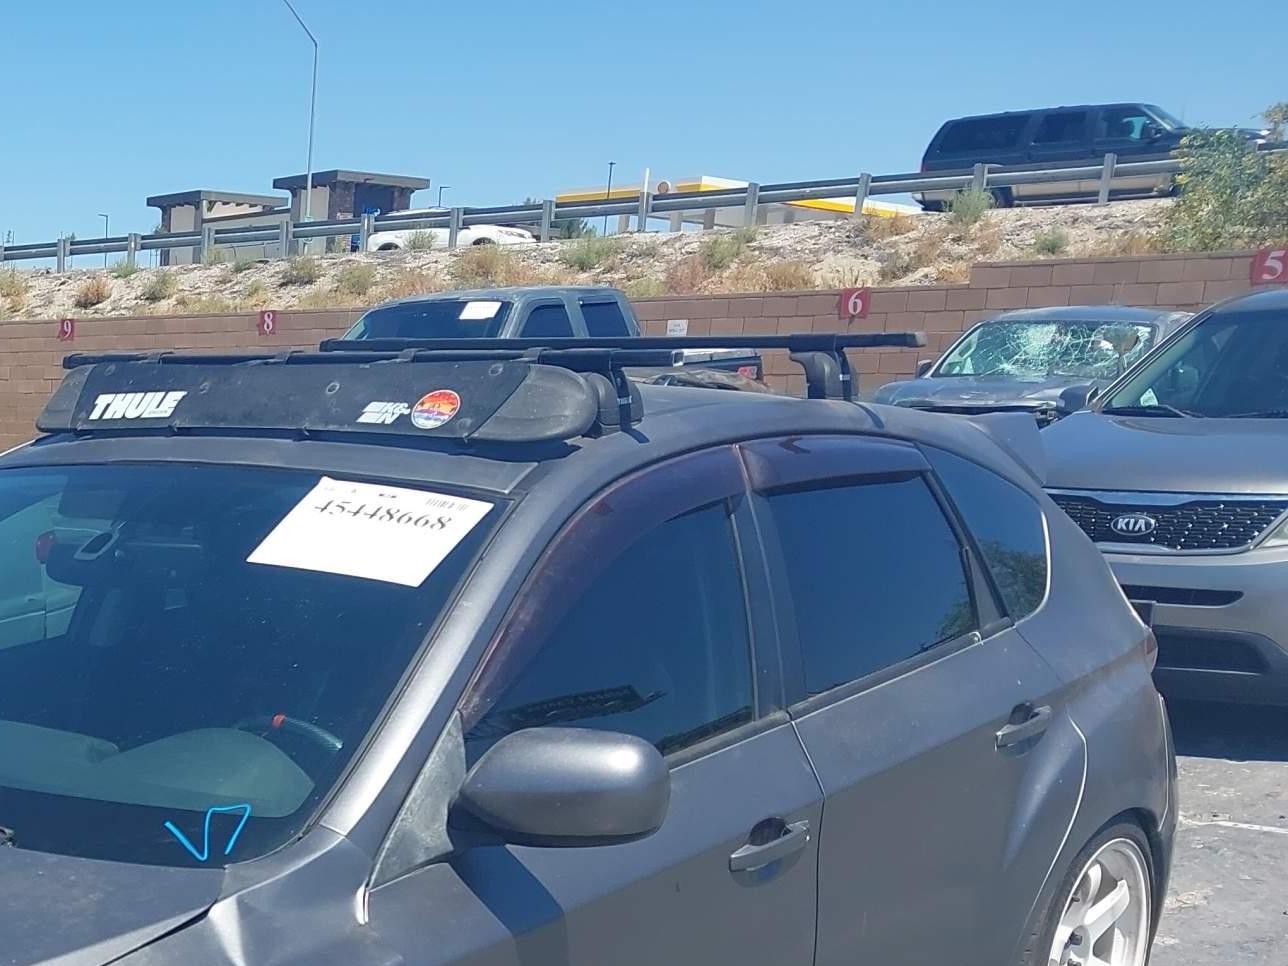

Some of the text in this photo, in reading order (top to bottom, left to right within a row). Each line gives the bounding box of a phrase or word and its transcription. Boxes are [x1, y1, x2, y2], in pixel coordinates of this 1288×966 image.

[1262, 250, 1286, 280] 5
[848, 289, 863, 315] 6
[63, 320, 72, 338] 9
[264, 311, 273, 331] 8
[89, 391, 188, 420] THULE
[315, 500, 452, 531] 45448668
[1117, 519, 1146, 531] KIA
